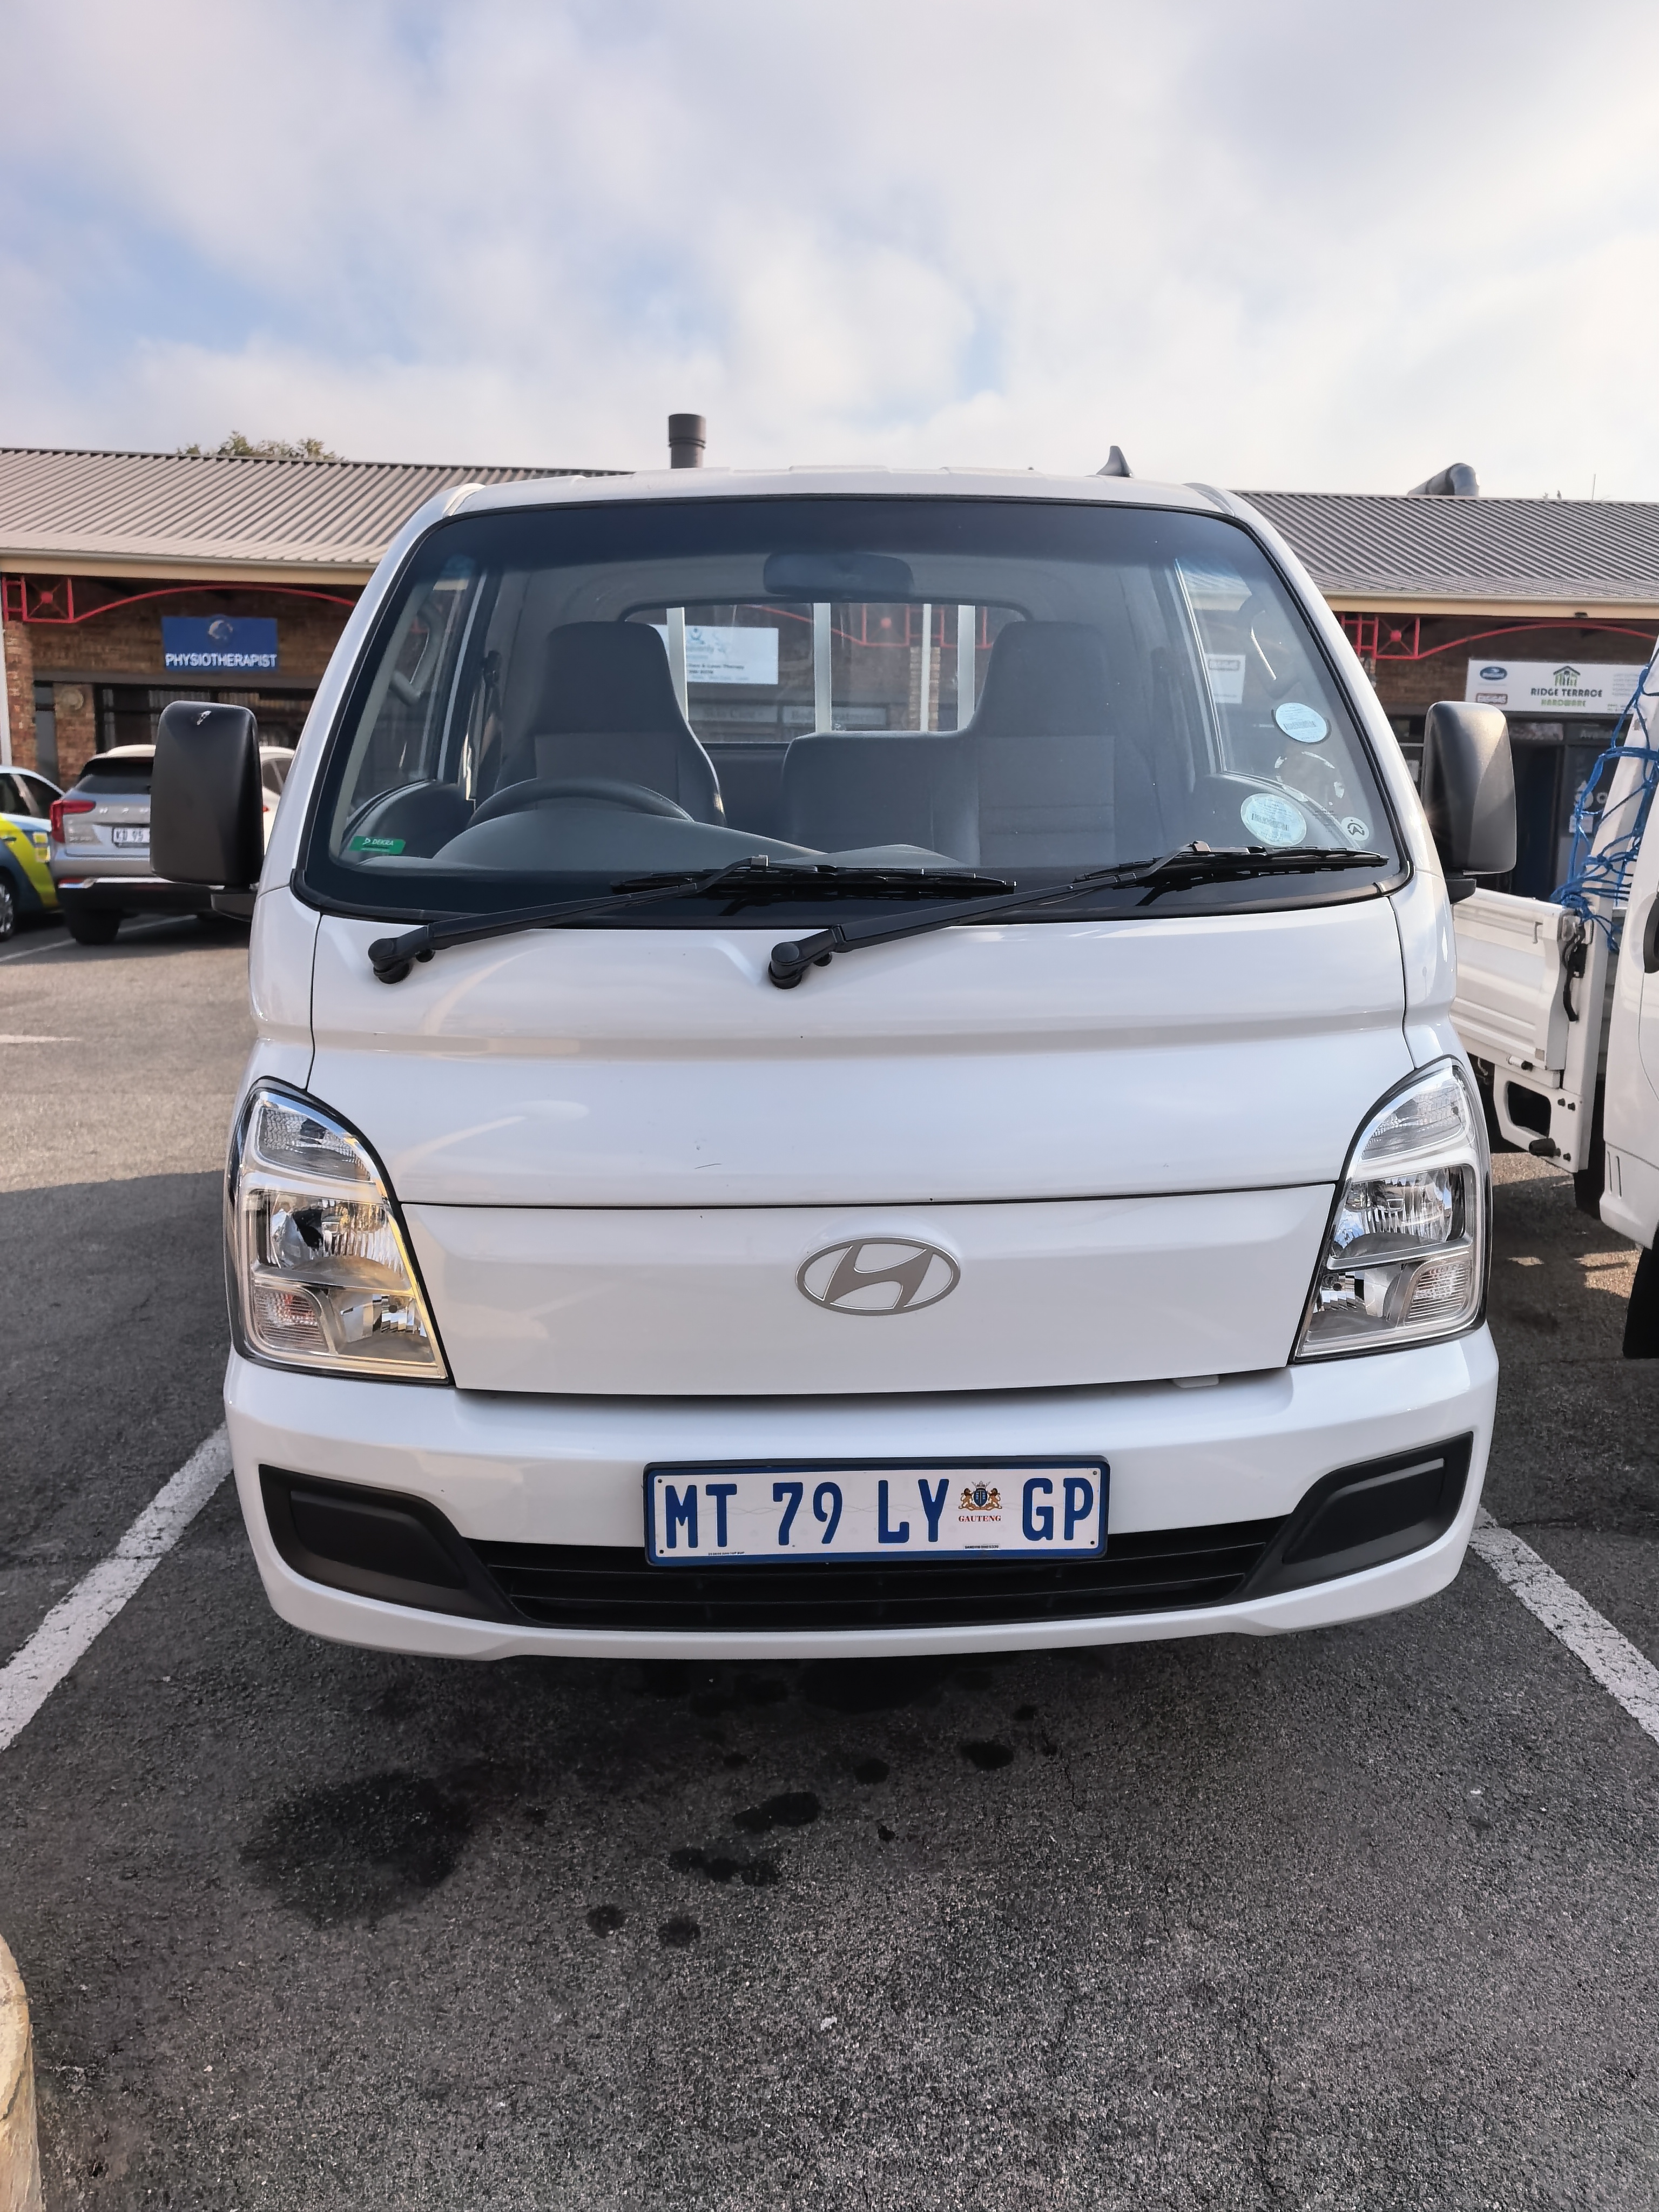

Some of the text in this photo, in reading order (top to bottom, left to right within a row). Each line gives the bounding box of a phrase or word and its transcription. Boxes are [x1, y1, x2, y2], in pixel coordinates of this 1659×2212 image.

[165, 652, 277, 667] PHYSIOTHERAPIST
[1530, 687, 1603, 698] RIDGE TERRACE
[665, 1477, 1094, 1549] MT 79 LY GP
